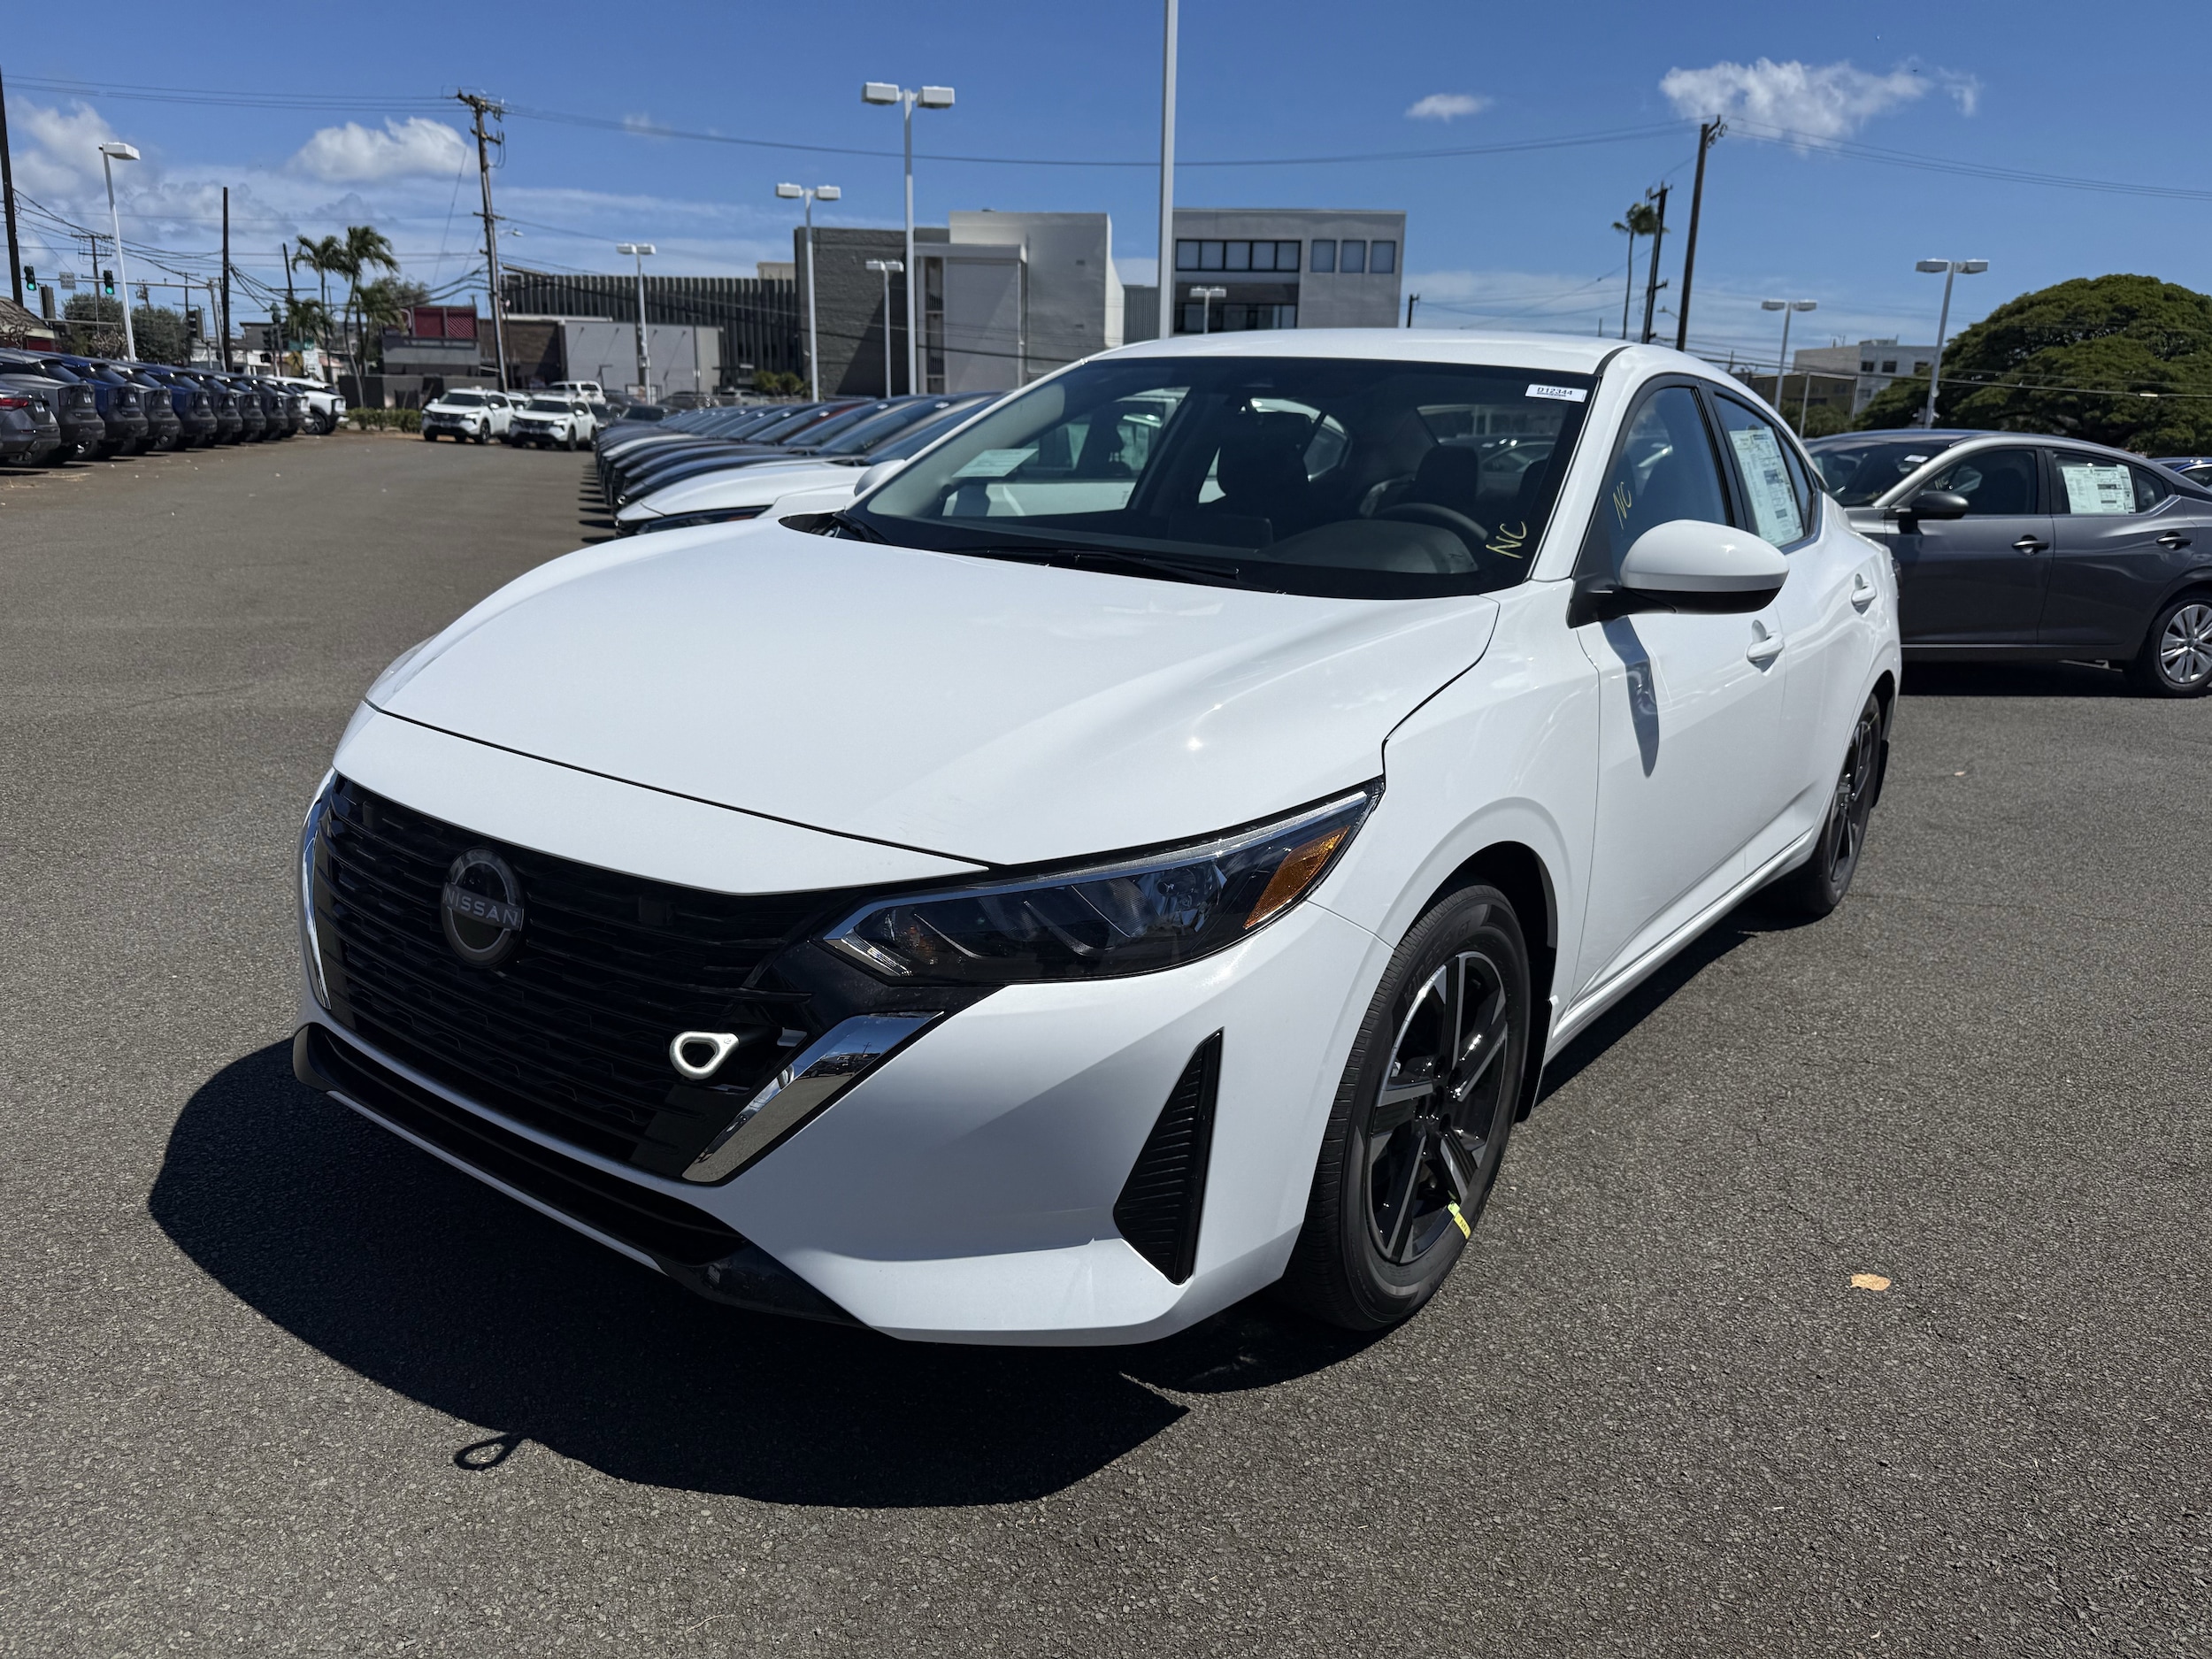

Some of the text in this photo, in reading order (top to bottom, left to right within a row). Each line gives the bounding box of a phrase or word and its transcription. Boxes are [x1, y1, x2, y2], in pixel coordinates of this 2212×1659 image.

[1612, 481, 1632, 531] NC
[1485, 520, 1527, 558] NC
[444, 887, 518, 926] NISSAN
